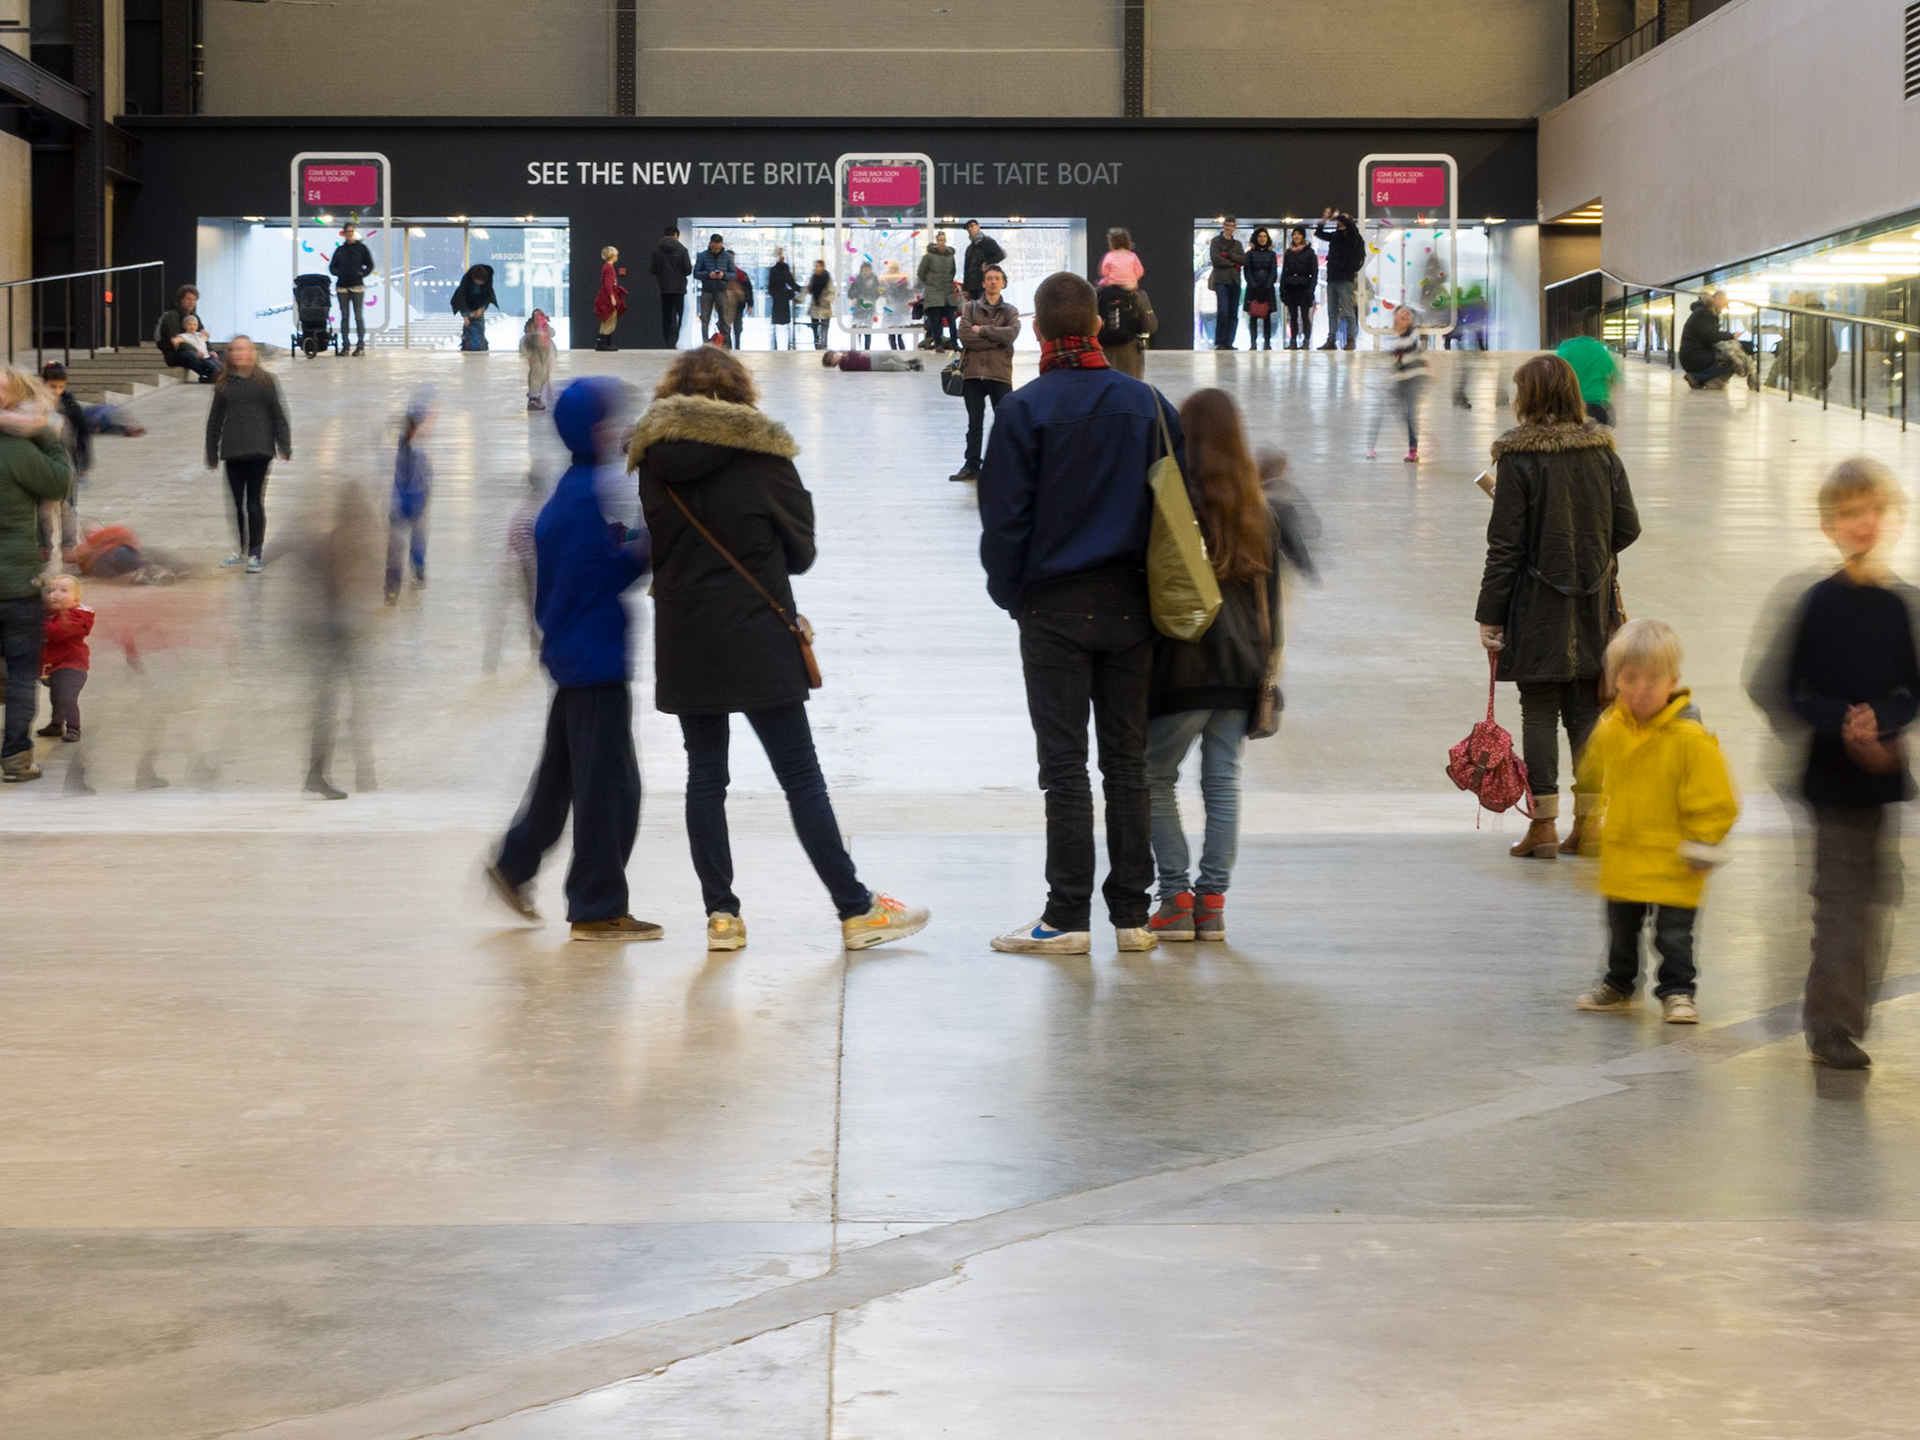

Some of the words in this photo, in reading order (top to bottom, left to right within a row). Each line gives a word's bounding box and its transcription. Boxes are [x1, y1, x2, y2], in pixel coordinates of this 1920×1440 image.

[527, 161, 569, 185] SEE
[577, 161, 624, 185] THE
[632, 161, 692, 185] NEW
[699, 162, 755, 185] TATE
[764, 162, 850, 185] BRITA
[938, 162, 985, 185] THE
[993, 162, 1049, 185] TATE
[1058, 162, 1122, 185] BOAT
[308, 190, 321, 201] £4
[852, 191, 865, 202] £4
[1377, 192, 1389, 202] £4
